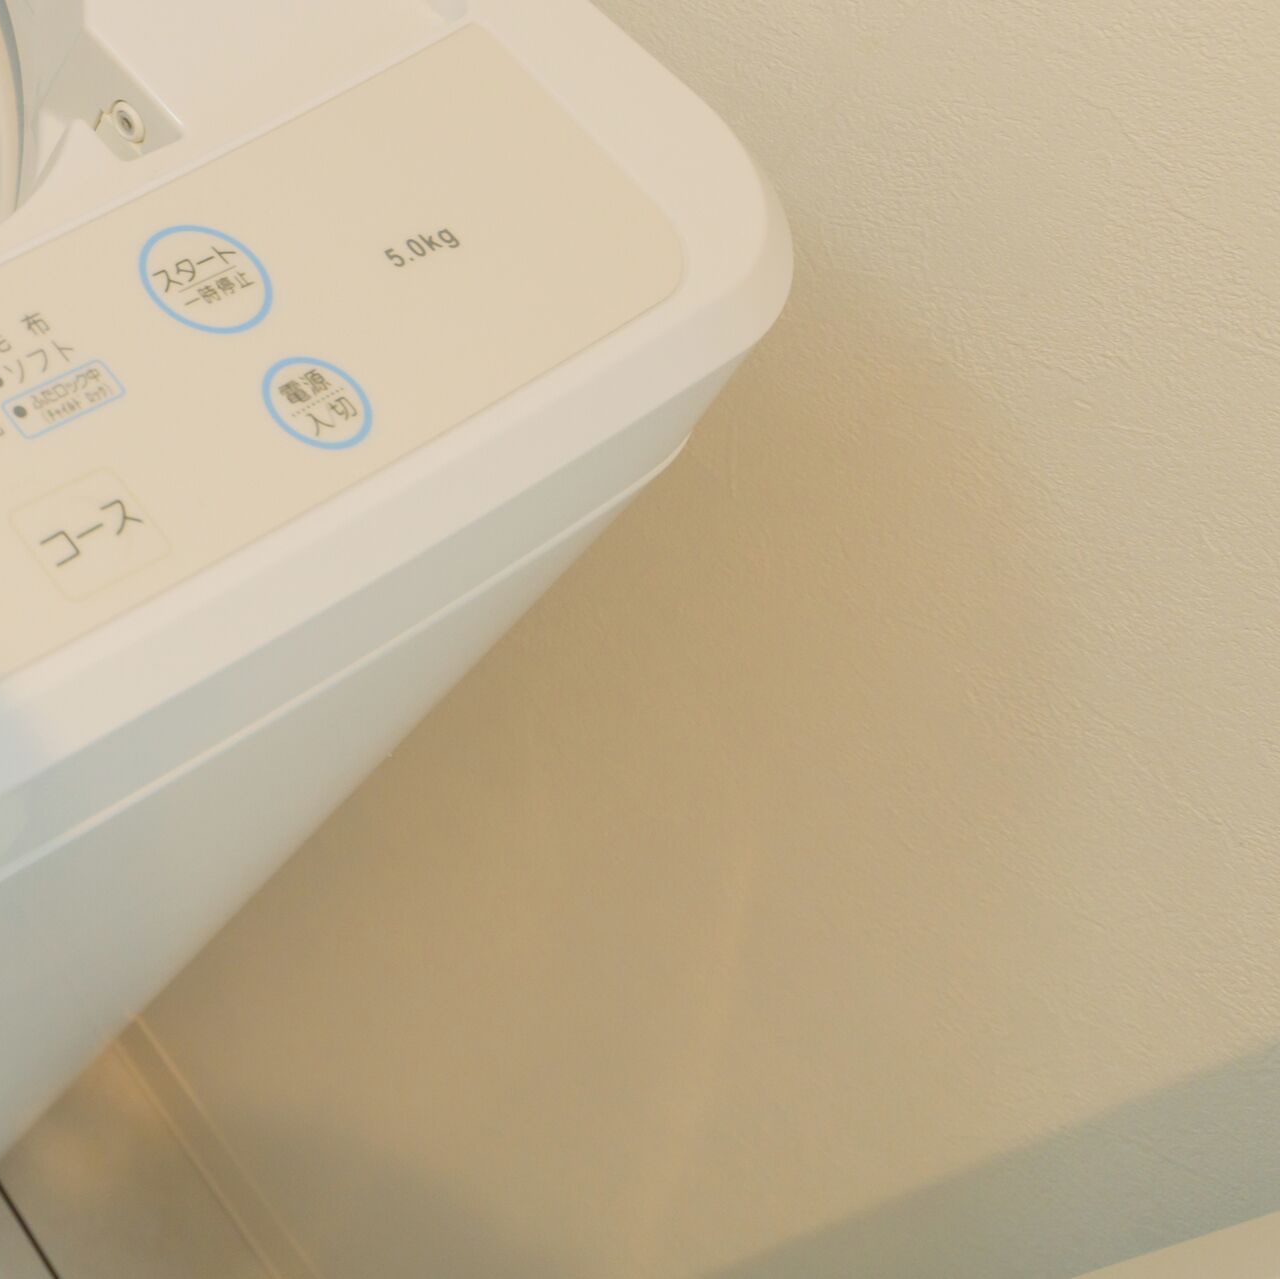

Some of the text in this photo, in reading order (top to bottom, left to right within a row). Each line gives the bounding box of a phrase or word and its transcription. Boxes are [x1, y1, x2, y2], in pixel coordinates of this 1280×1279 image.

[151, 246, 237, 293] スタート
[382, 227, 461, 269] 5.0kg
[183, 271, 256, 307] 一時停止
[3, 340, 75, 384] ソフト
[277, 368, 332, 406] 電源
[39, 499, 145, 568] コース
